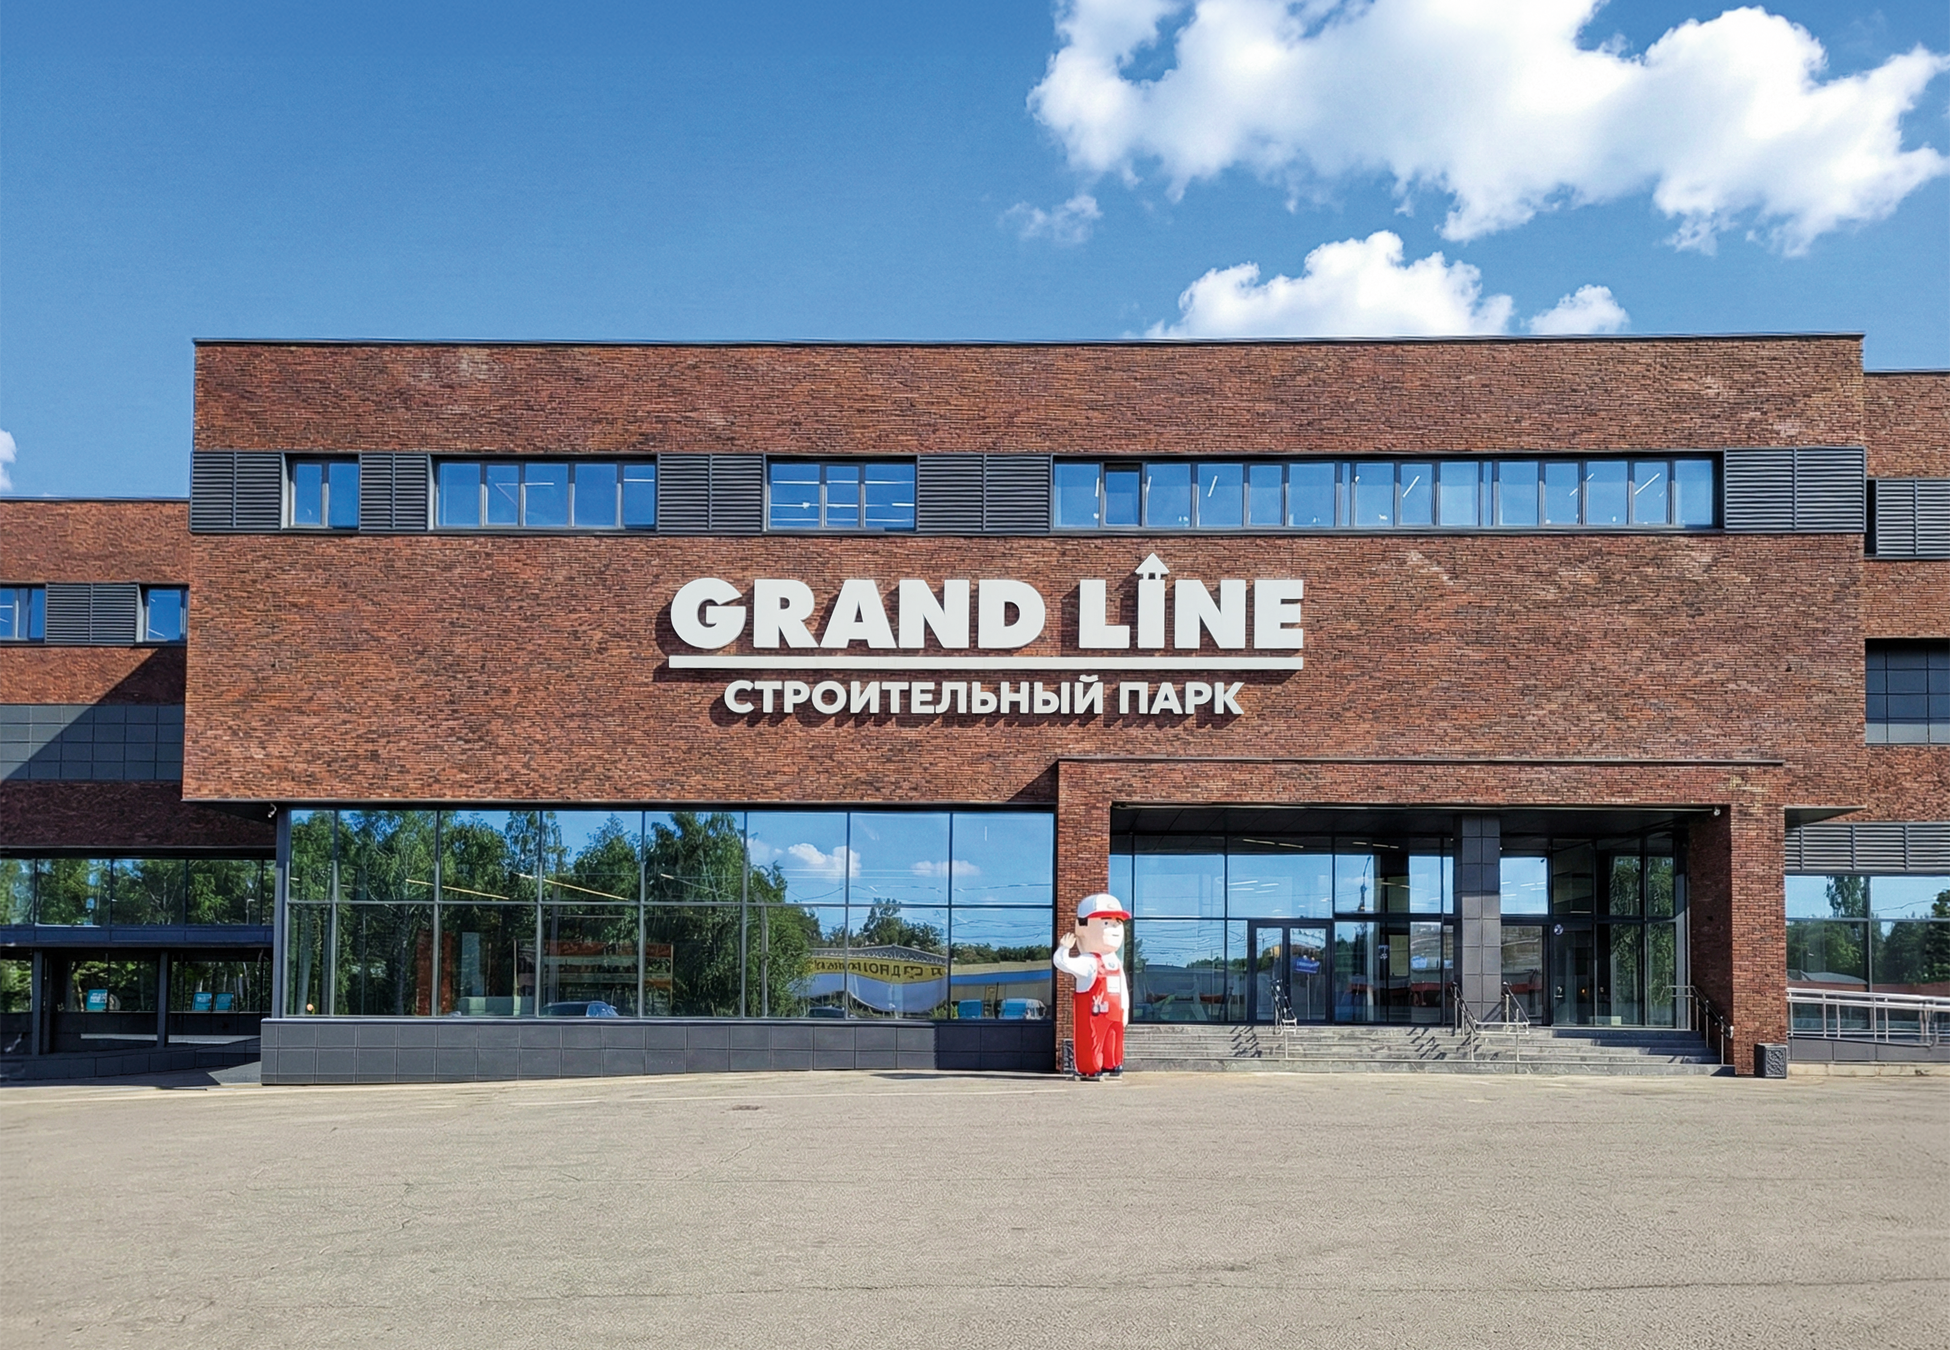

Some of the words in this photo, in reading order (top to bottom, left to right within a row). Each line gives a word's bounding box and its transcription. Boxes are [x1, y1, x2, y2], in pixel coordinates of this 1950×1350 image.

[670, 577, 1047, 649] GRAND
[1078, 553, 1304, 649] LINE
[724, 674, 1104, 714] СТРОИТЕЛЬНЫЙ
[1119, 681, 1245, 715] ПАРК
